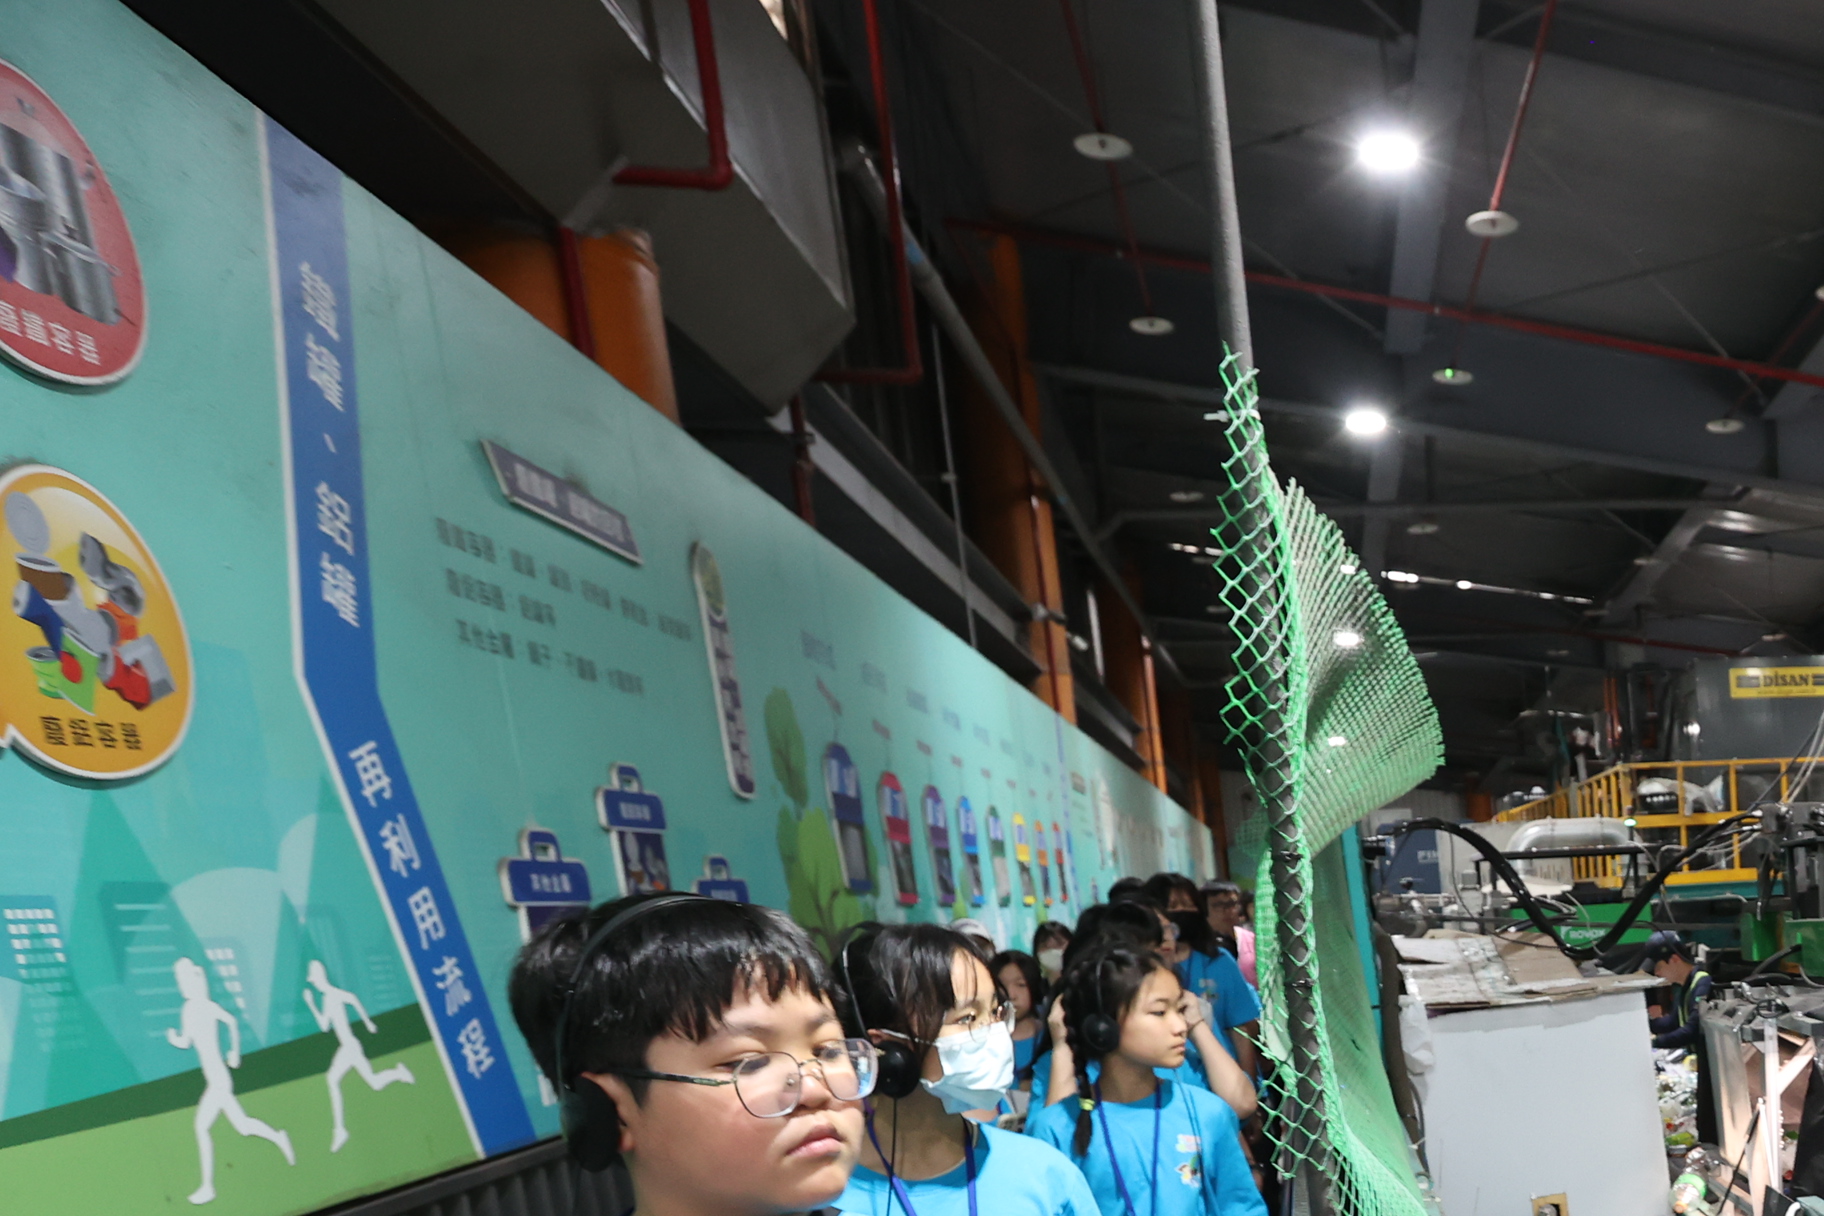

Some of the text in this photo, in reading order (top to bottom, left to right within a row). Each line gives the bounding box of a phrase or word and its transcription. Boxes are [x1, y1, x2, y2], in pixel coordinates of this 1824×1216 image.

[349, 740, 496, 1080] 再利用流程
